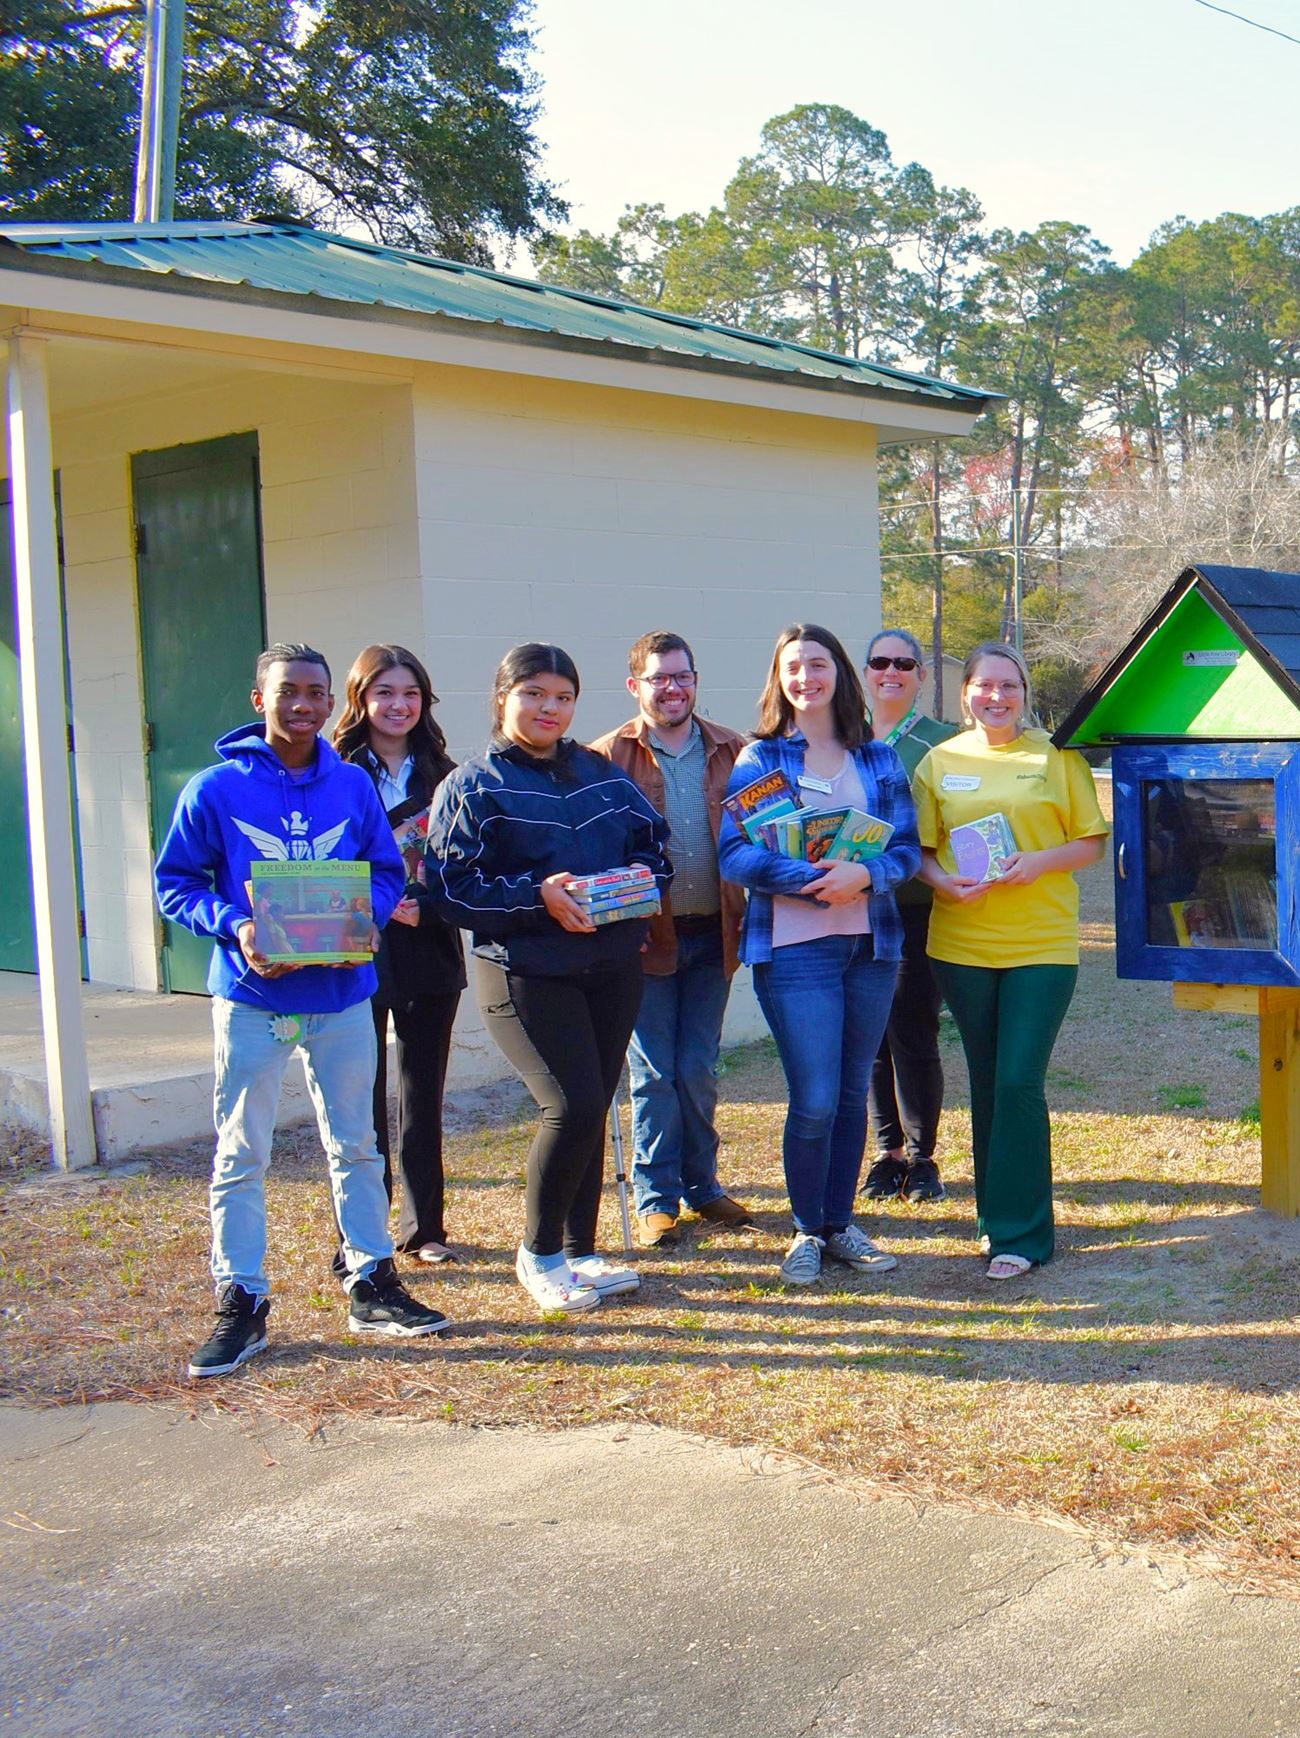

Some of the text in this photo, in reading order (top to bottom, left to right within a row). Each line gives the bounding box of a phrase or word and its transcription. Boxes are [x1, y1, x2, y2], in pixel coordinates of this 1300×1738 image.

[738, 776, 785, 811] KANAN
[852, 821, 884, 844] JO
[260, 864, 312, 872] FREEDOM
[331, 864, 361, 872] MENU
